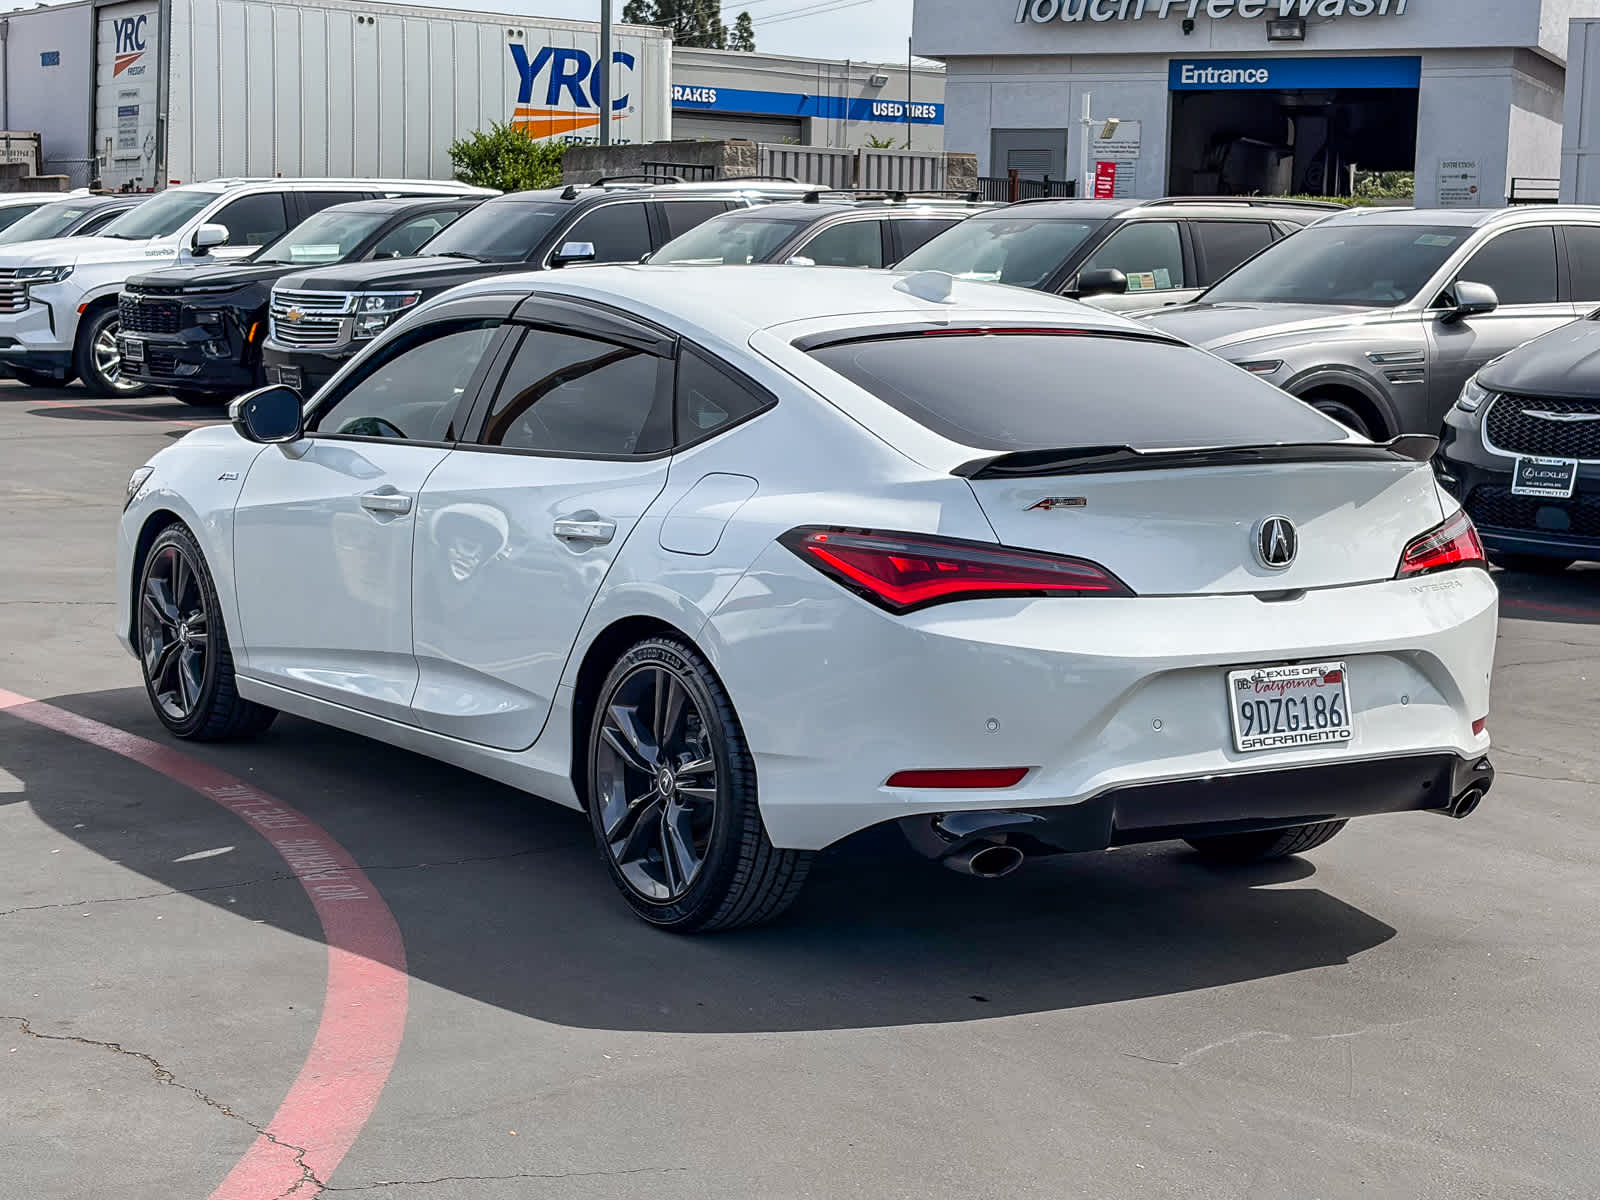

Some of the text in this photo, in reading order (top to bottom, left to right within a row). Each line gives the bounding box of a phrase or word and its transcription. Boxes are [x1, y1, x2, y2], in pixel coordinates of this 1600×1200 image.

[113, 14, 147, 53] YRC
[508, 43, 635, 111] YRC
[1181, 65, 1268, 83] Entrance
[873, 102, 936, 118] USED TIRES
[1535, 470, 1569, 479] LEXUS
[1409, 580, 1463, 593] INTEGRA
[1257, 669, 1300, 679] LEXUS
[1241, 692, 1342, 737] 9DZG186
[1241, 729, 1351, 749] SACRAMENTO
